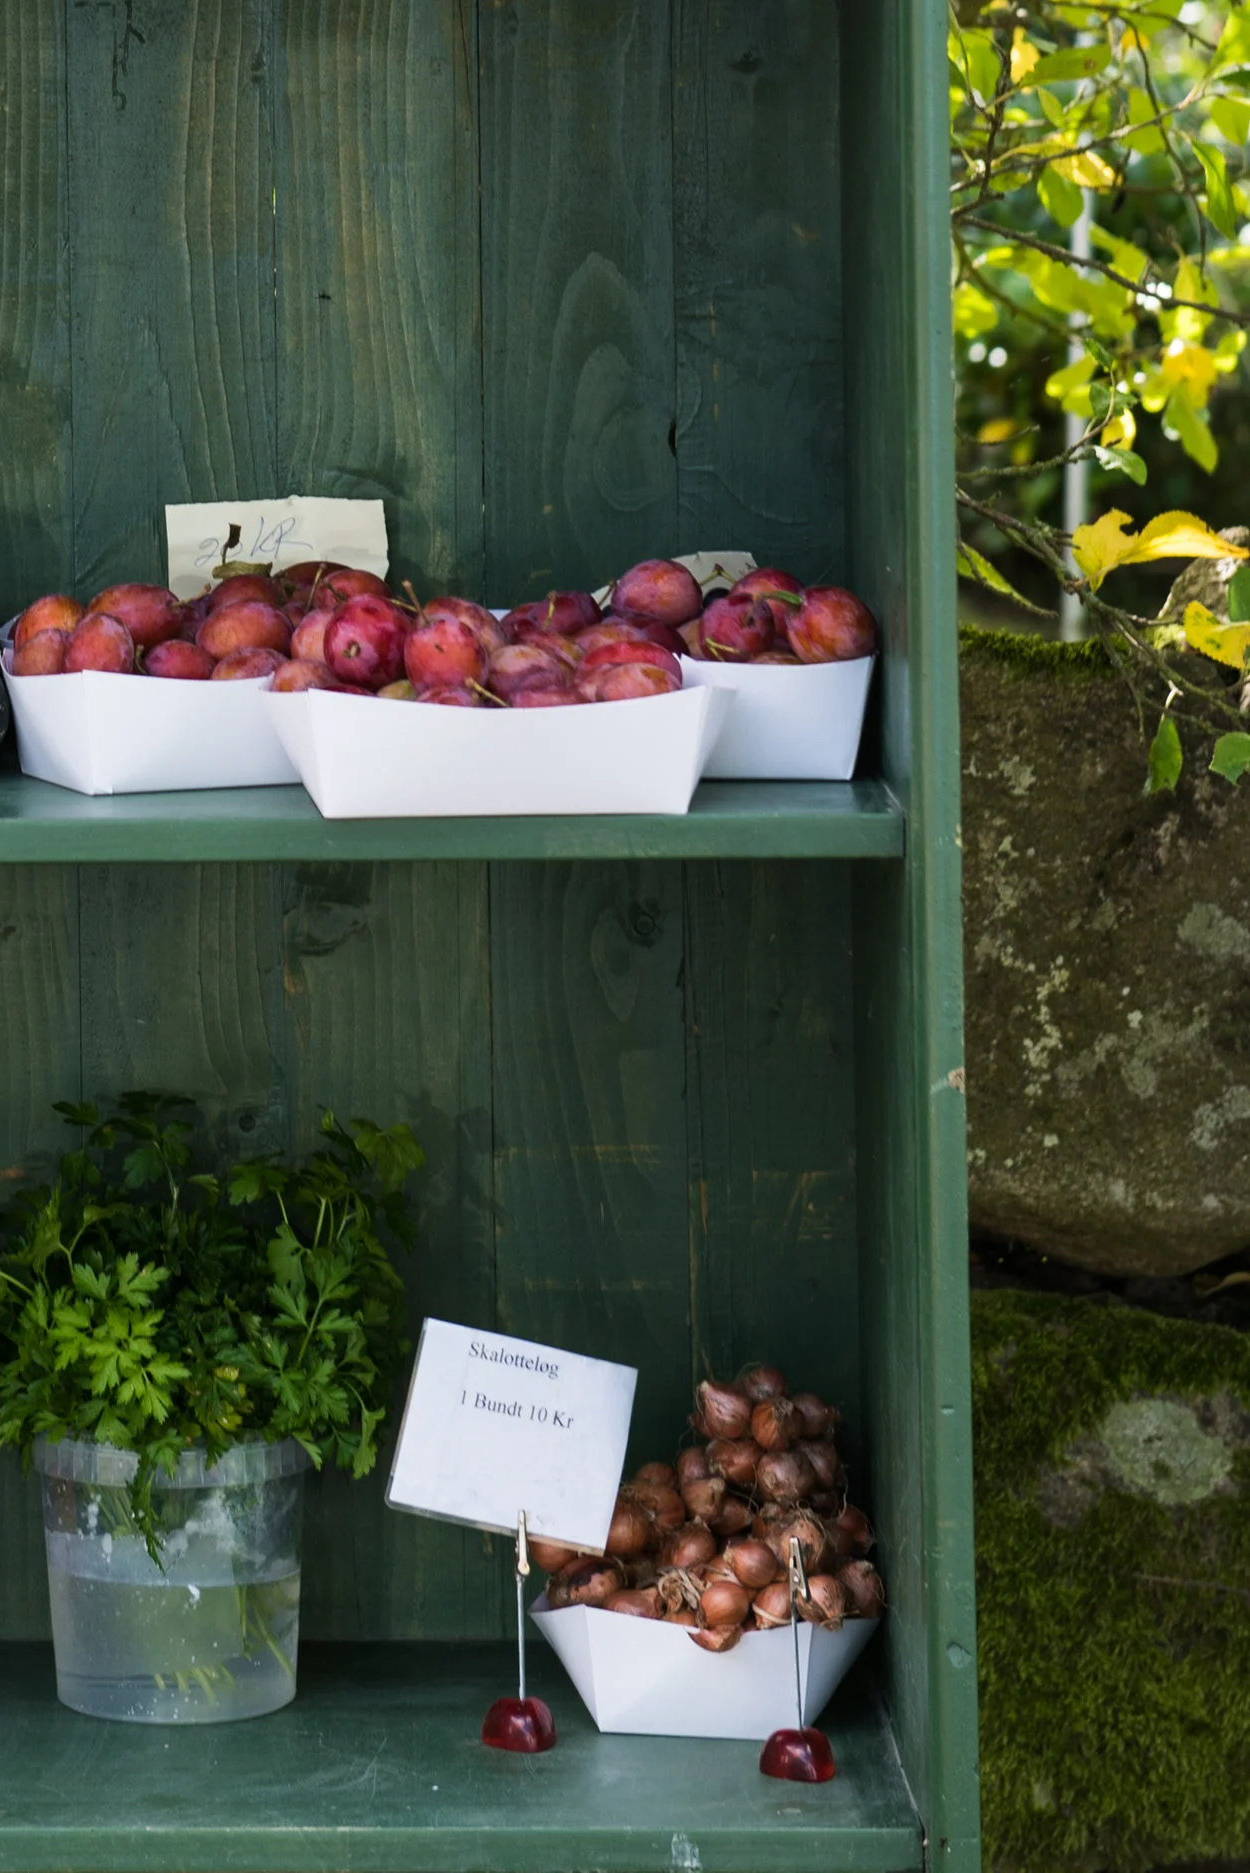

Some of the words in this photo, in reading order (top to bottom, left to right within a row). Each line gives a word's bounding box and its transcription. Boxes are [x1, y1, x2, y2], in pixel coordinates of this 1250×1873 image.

[473, 1392, 524, 1419] Bundt
[529, 1405, 548, 1423] 10
[552, 1410, 575, 1430] Kr
